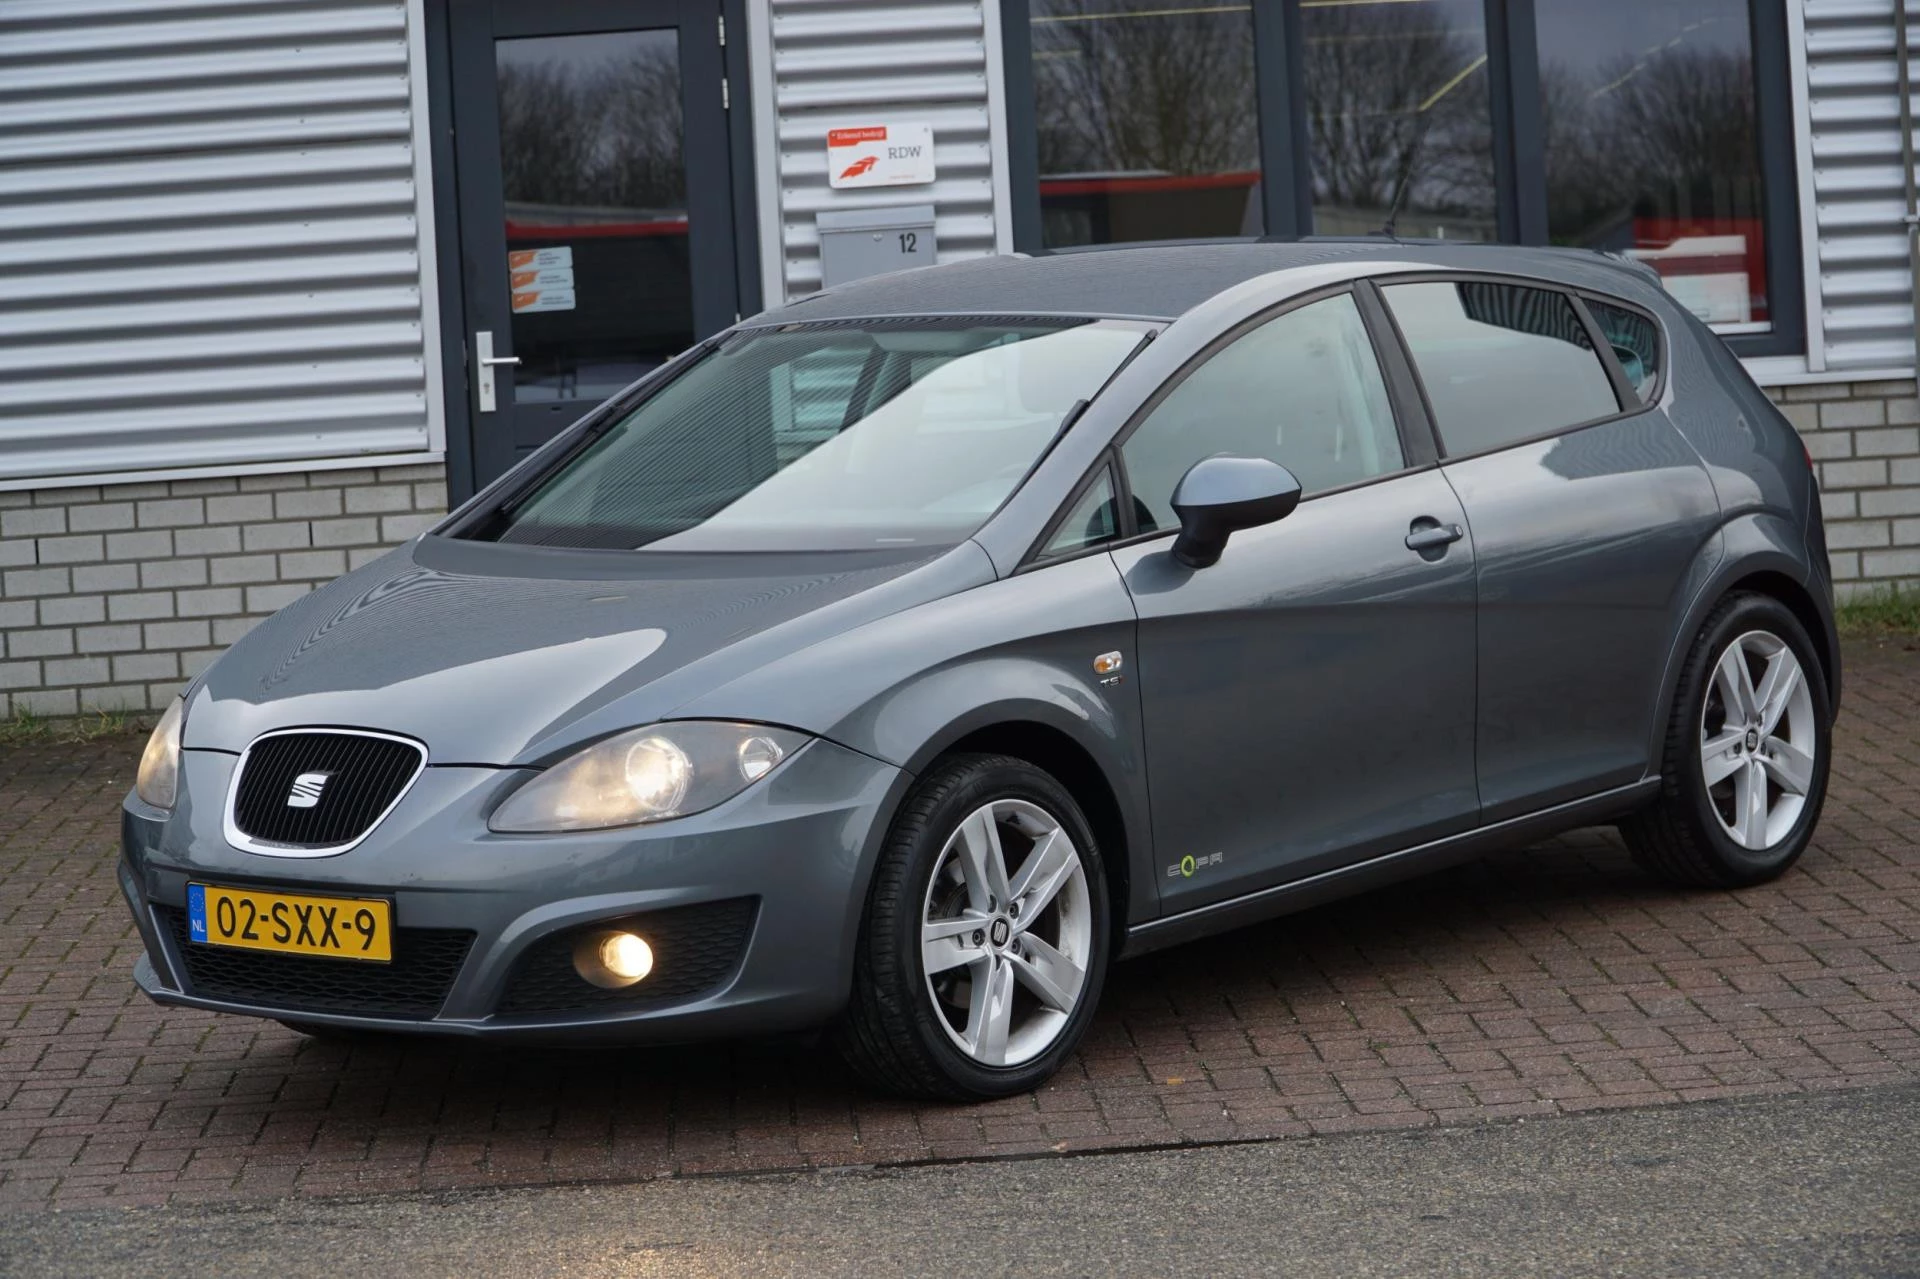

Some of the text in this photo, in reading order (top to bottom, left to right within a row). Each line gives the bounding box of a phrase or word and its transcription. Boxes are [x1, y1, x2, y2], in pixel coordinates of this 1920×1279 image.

[888, 145, 922, 160] RDW
[899, 232, 917, 254] 12
[1167, 851, 1223, 878] COPA
[191, 919, 206, 933] NL
[216, 896, 376, 951] 02-SXX-9
